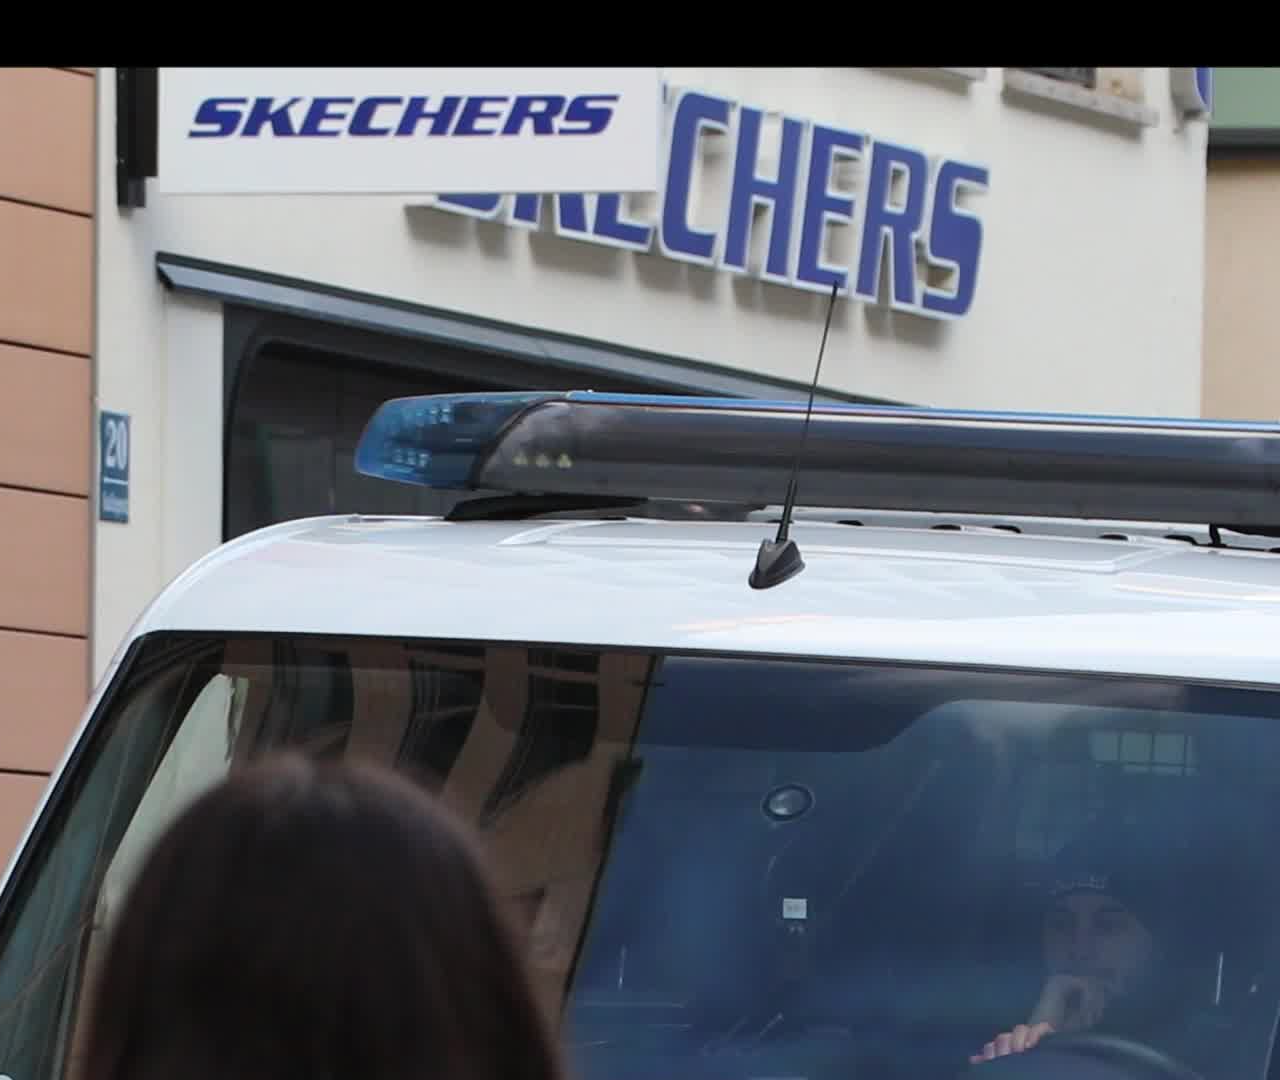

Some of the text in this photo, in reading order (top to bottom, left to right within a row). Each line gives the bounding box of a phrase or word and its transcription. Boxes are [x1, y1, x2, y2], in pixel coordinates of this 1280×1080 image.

[189, 95, 620, 138] SKECHERS
[435, 90, 990, 317] CHERS
[105, 419, 127, 470] 20
